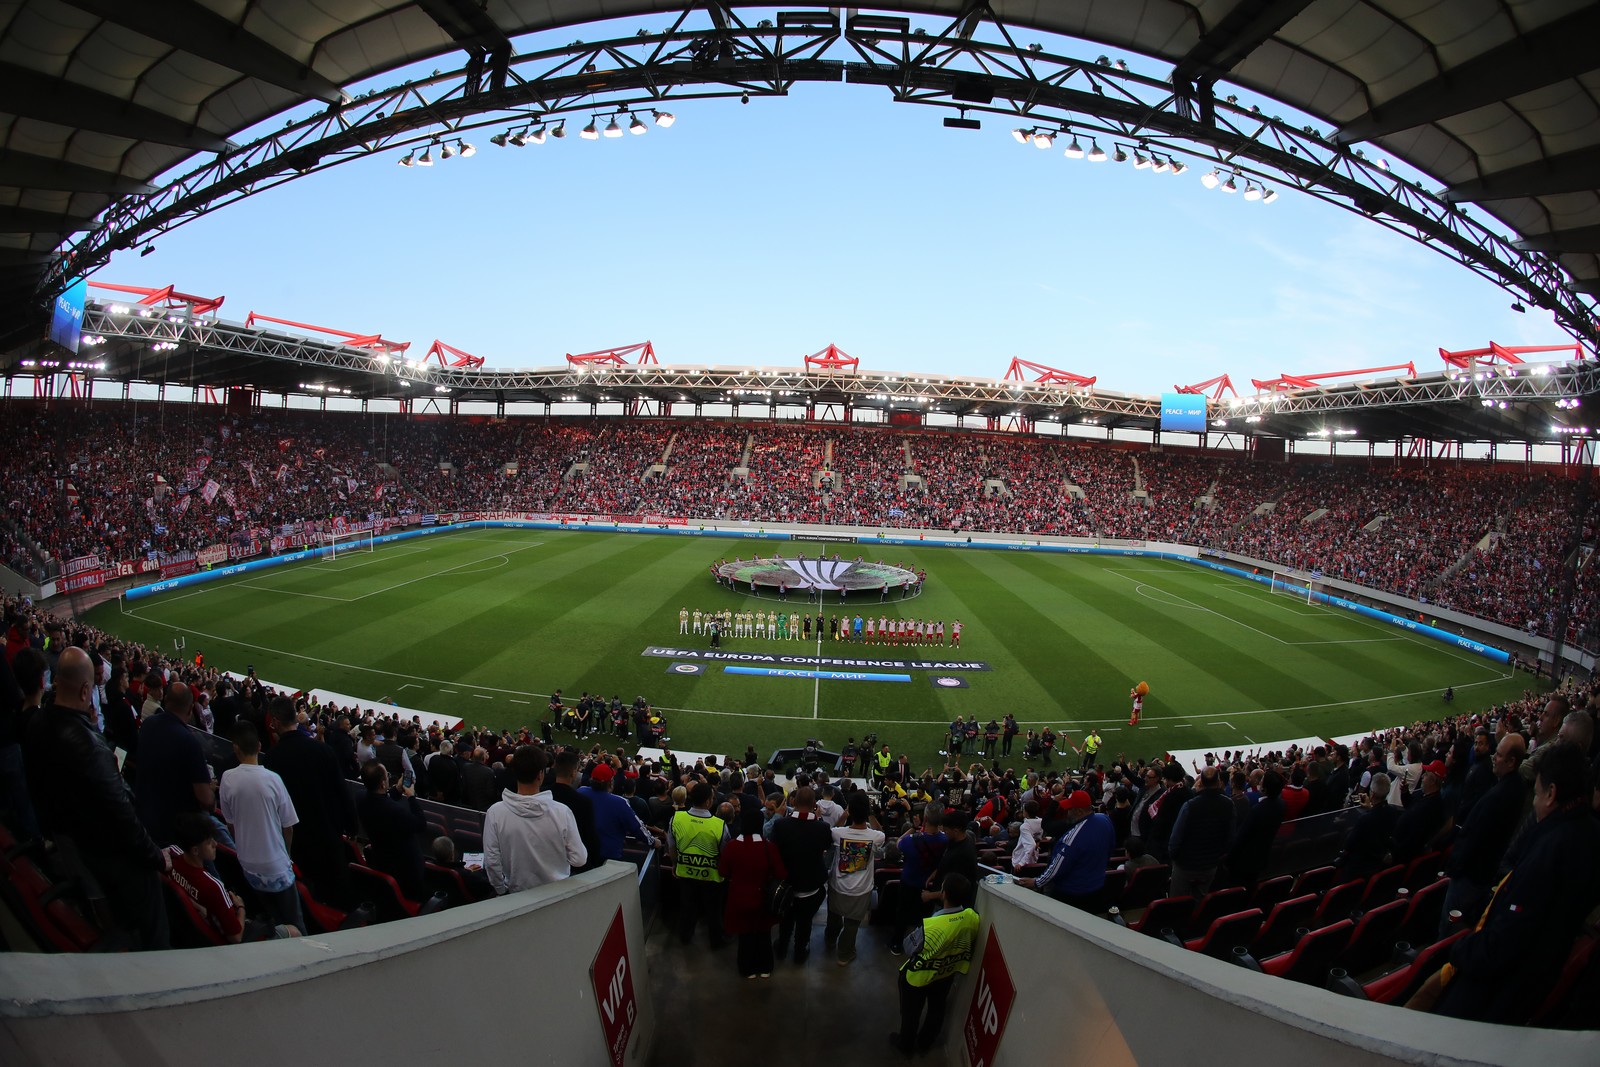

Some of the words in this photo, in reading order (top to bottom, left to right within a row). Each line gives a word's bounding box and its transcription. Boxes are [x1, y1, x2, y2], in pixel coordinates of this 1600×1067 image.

[58, 296, 71, 314] PEACE
[151, 585, 166, 593] PEACE
[1336, 600, 1347, 608] PEACE
[1392, 617, 1404, 626] PEACE
[1457, 638, 1471, 648] PEACE
[652, 648, 699, 657] UEFA
[703, 652, 775, 662] EUROPA
[779, 656, 905, 668] CONFERENCE
[768, 669, 815, 677] PEACE
[677, 854, 719, 868] TEWAR
[686, 866, 710, 878] 370
[171, 868, 199, 900] RODINEI
[602, 955, 627, 1025] VIP
[977, 967, 998, 1036] VIP
[626, 999, 634, 1027] B
